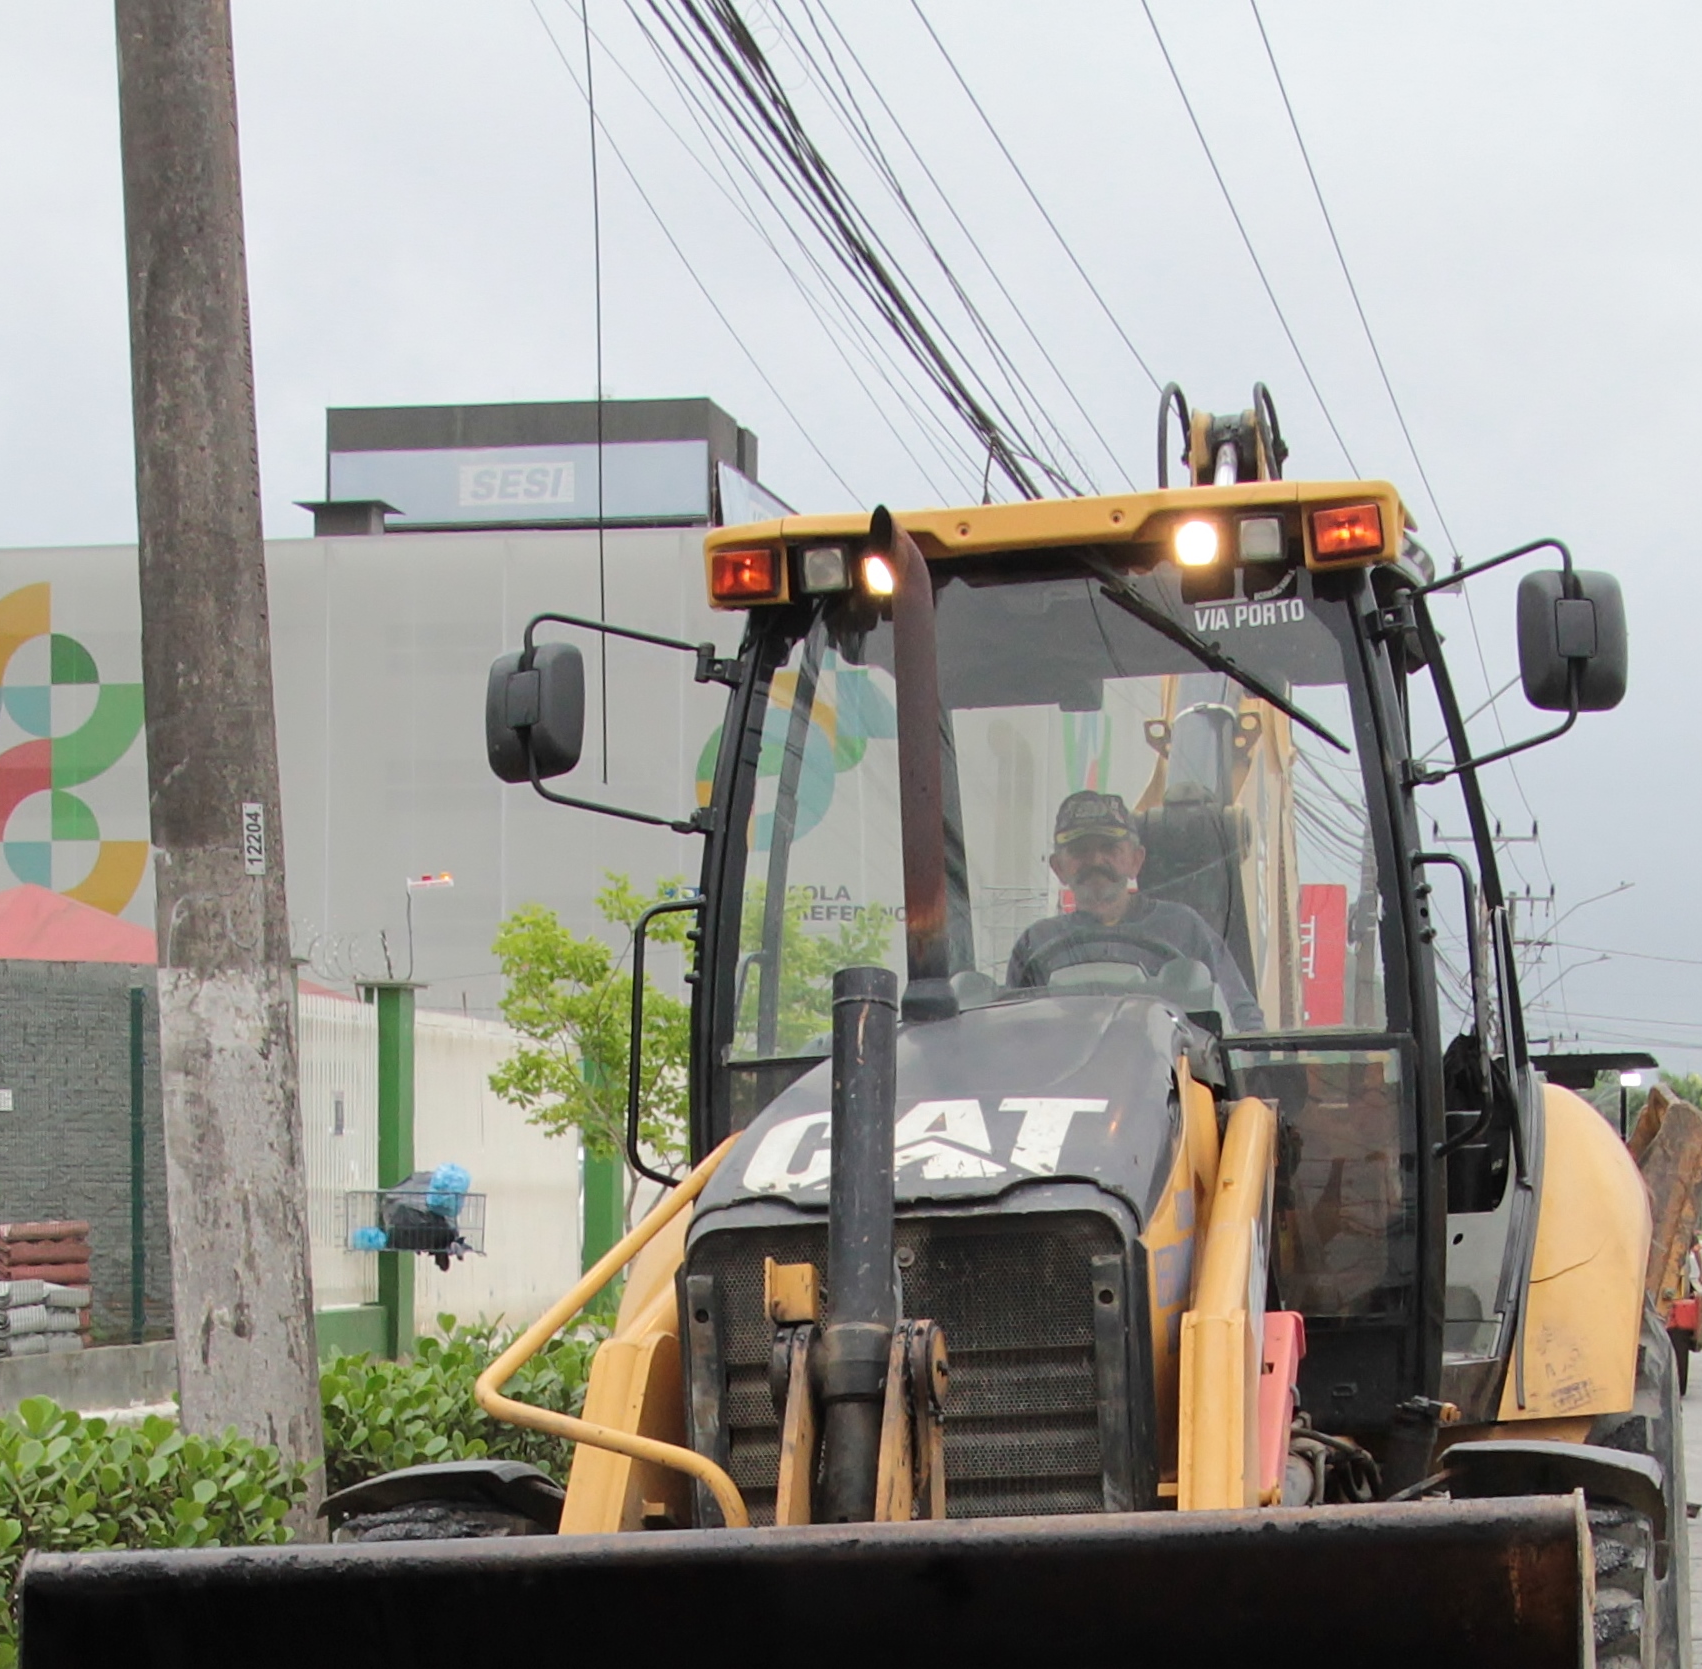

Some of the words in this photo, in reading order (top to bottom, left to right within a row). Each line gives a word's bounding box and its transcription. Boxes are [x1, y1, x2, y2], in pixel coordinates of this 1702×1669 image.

[471, 466, 564, 500] SESI
[1194, 607, 1230, 632] VIA
[1235, 598, 1305, 629] PORTO
[245, 810, 264, 867] 12204
[743, 1097, 1109, 1193] CAT
